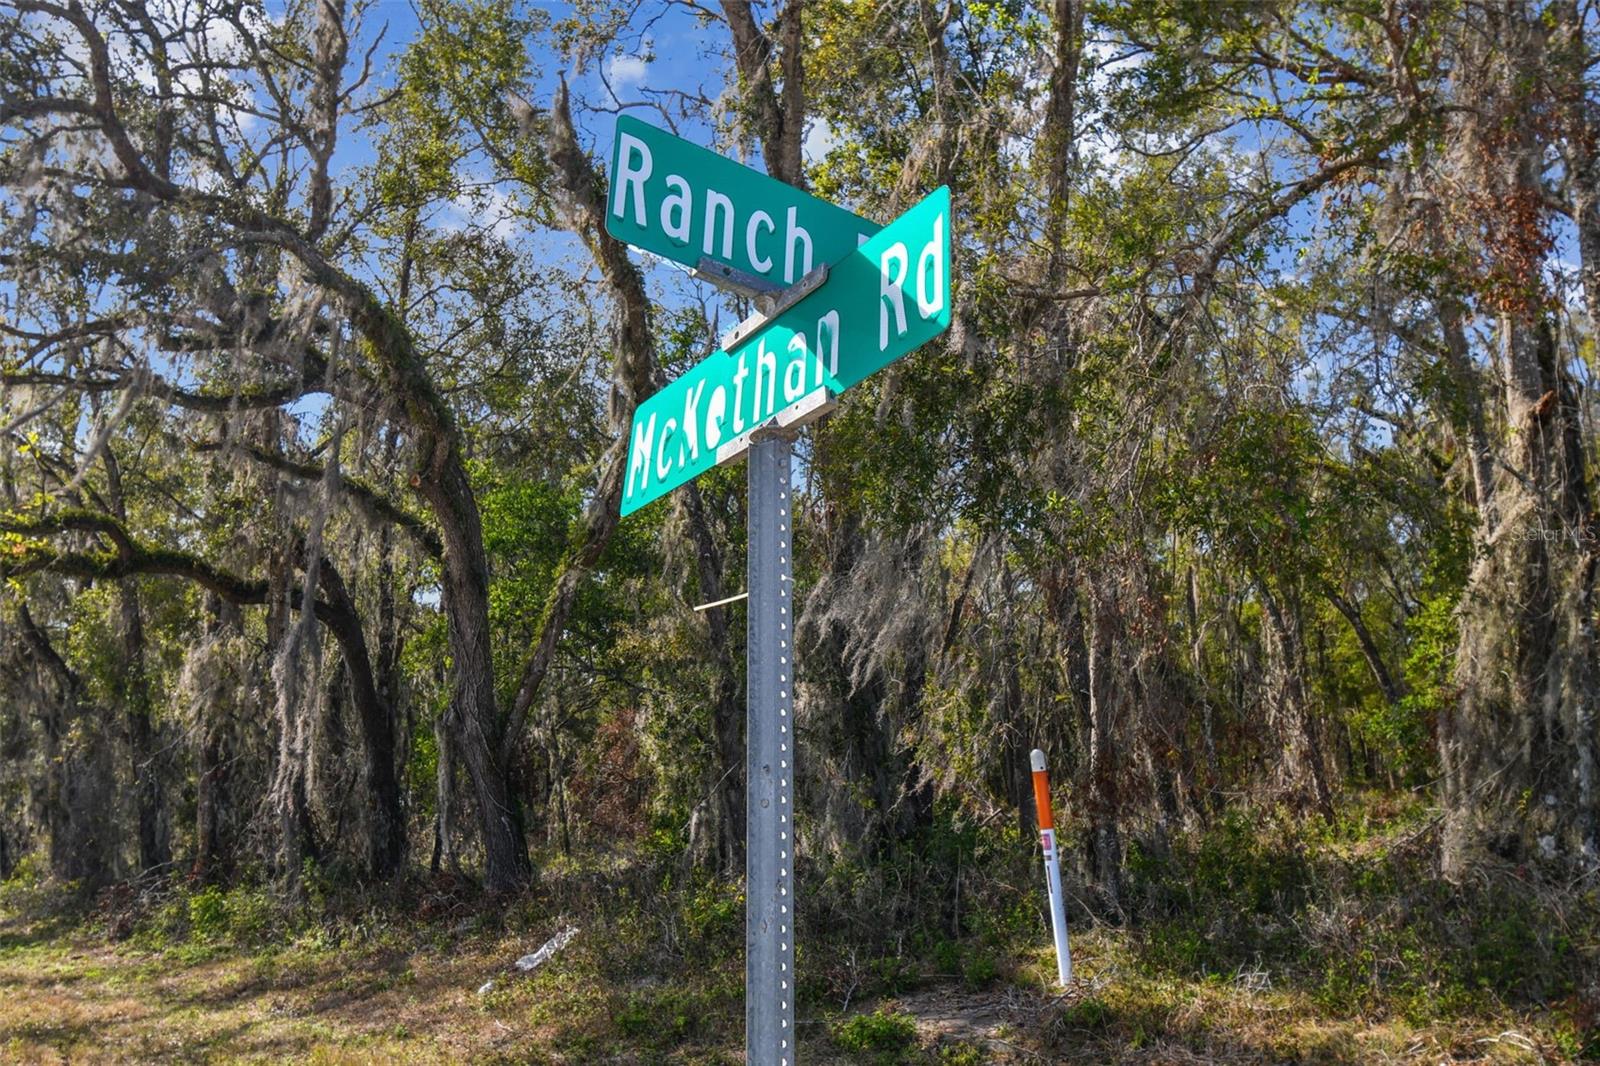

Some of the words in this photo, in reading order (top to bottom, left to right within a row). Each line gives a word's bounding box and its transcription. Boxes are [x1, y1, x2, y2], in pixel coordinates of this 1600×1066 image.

[612, 132, 814, 284] Ranch
[626, 309, 840, 498] McKethan
[879, 212, 944, 351] Rd
